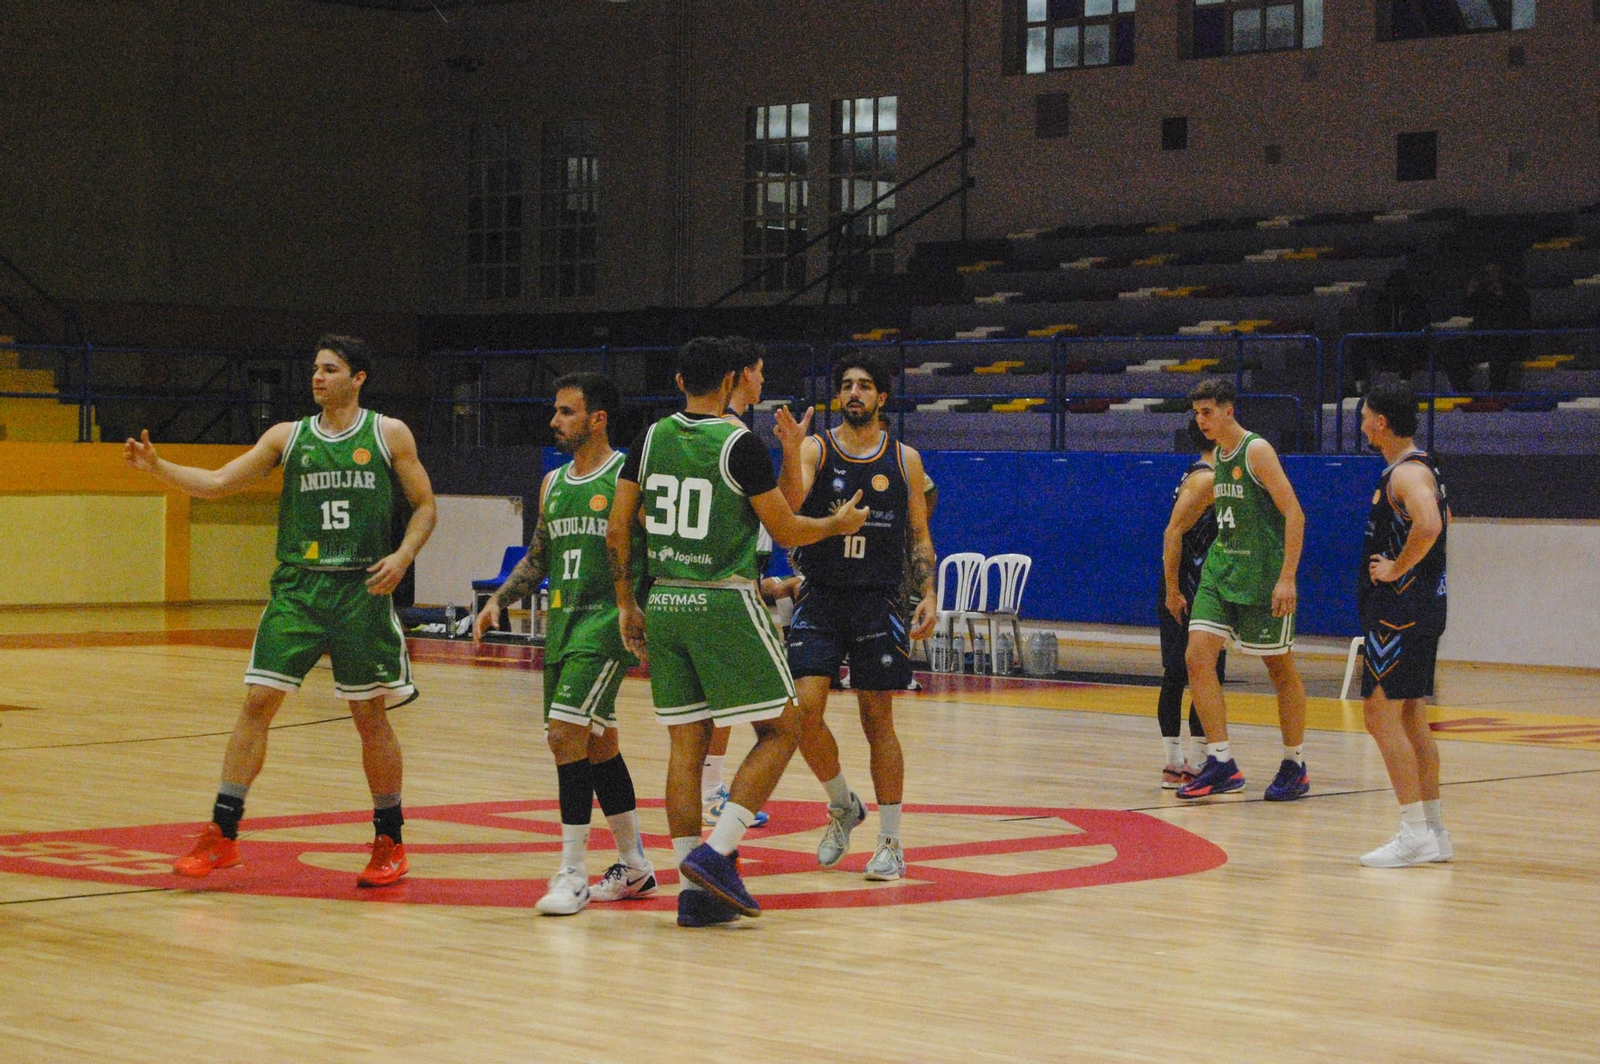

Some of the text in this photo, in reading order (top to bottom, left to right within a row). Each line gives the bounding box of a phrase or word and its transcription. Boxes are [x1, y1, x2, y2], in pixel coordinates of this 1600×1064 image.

[300, 470, 375, 492] ANDUJAR
[321, 500, 350, 530] 15
[645, 473, 713, 540] 30
[1216, 505, 1236, 529] 44
[674, 551, 713, 565] logistik
[843, 535, 866, 559] 10
[562, 549, 582, 580] 17
